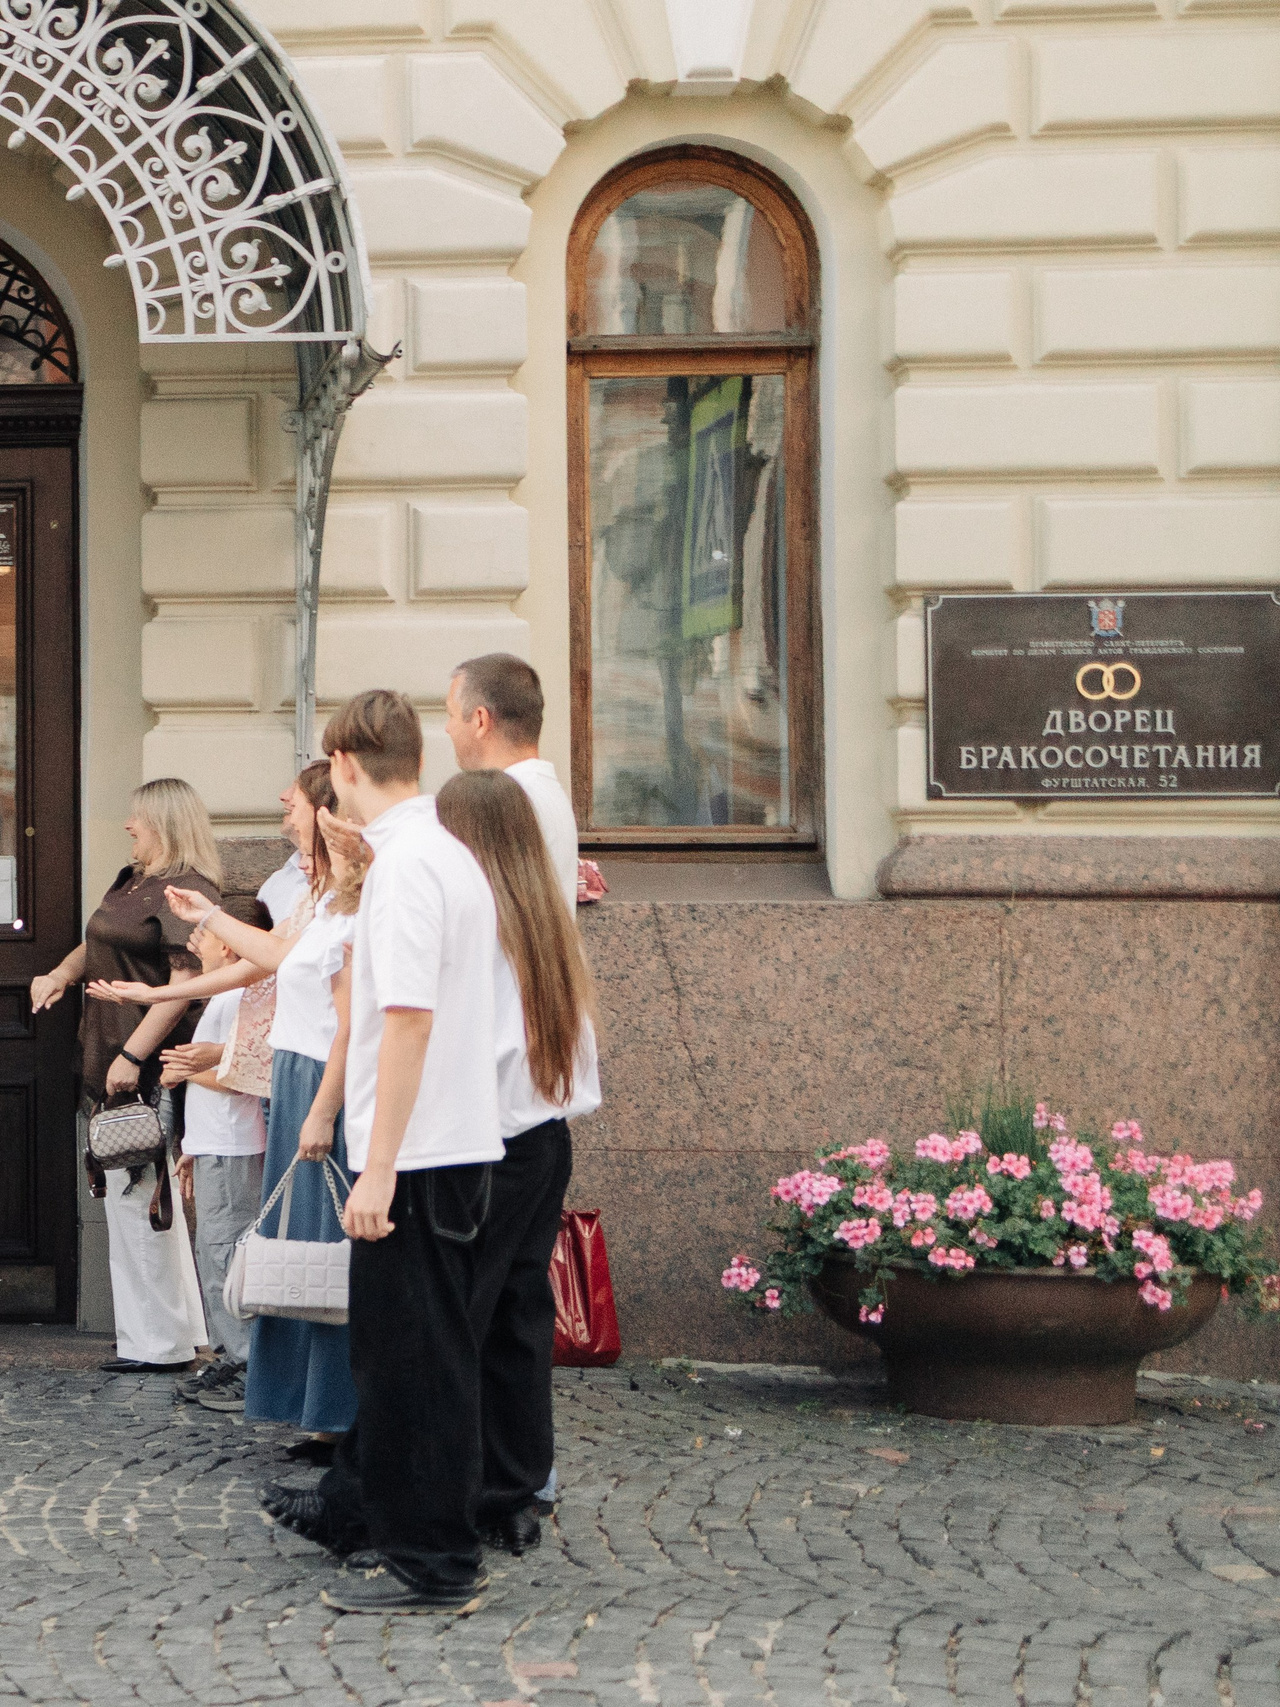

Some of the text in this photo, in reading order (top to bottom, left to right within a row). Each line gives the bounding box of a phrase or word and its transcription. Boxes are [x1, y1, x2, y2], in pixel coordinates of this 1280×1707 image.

[1041, 709, 1177, 736] ДВОРЕЦ
[959, 744, 1262, 770] БРАКОСОЧЕТАНИЯ
[1157, 775, 1179, 788] 52
